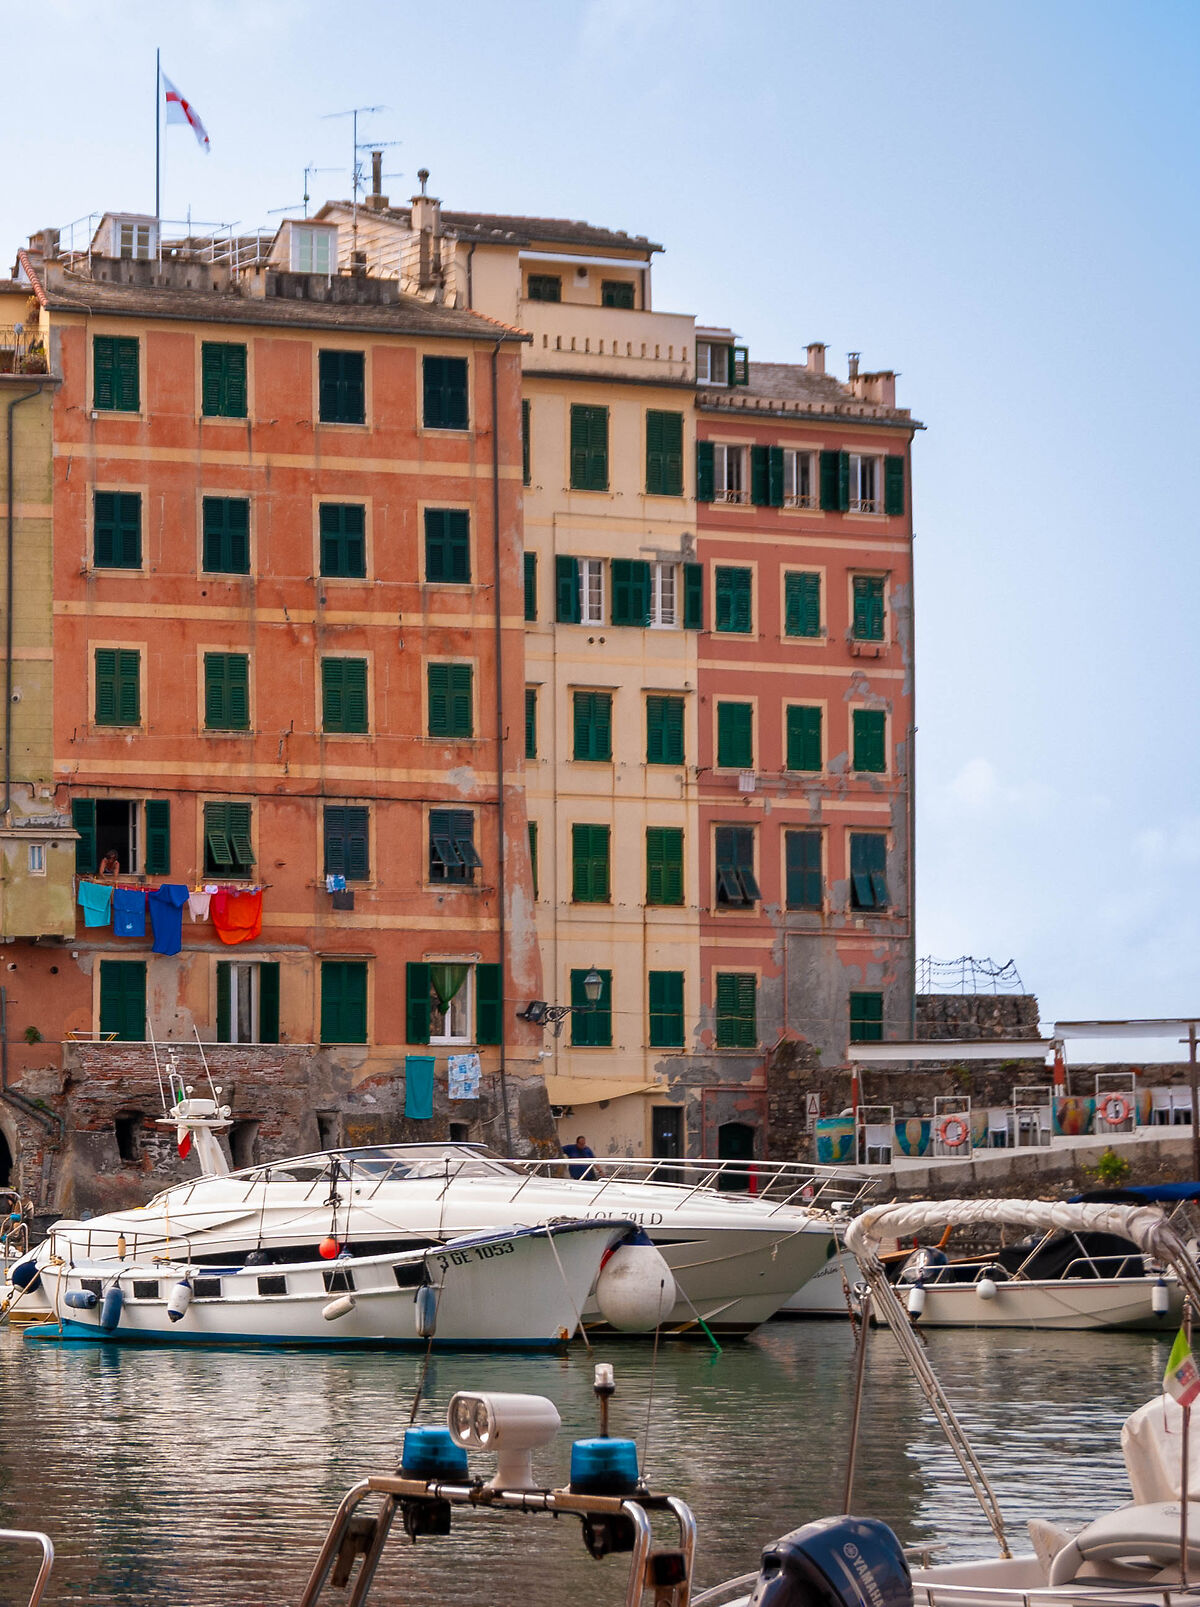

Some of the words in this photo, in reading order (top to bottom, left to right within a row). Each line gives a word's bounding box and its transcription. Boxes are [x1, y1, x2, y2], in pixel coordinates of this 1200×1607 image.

[649, 1212, 663, 1225] D
[437, 1255, 449, 1270] 3
[450, 1250, 473, 1266] GE
[475, 1241, 515, 1260] 1053
[853, 1555, 884, 1607] YAMAHA
